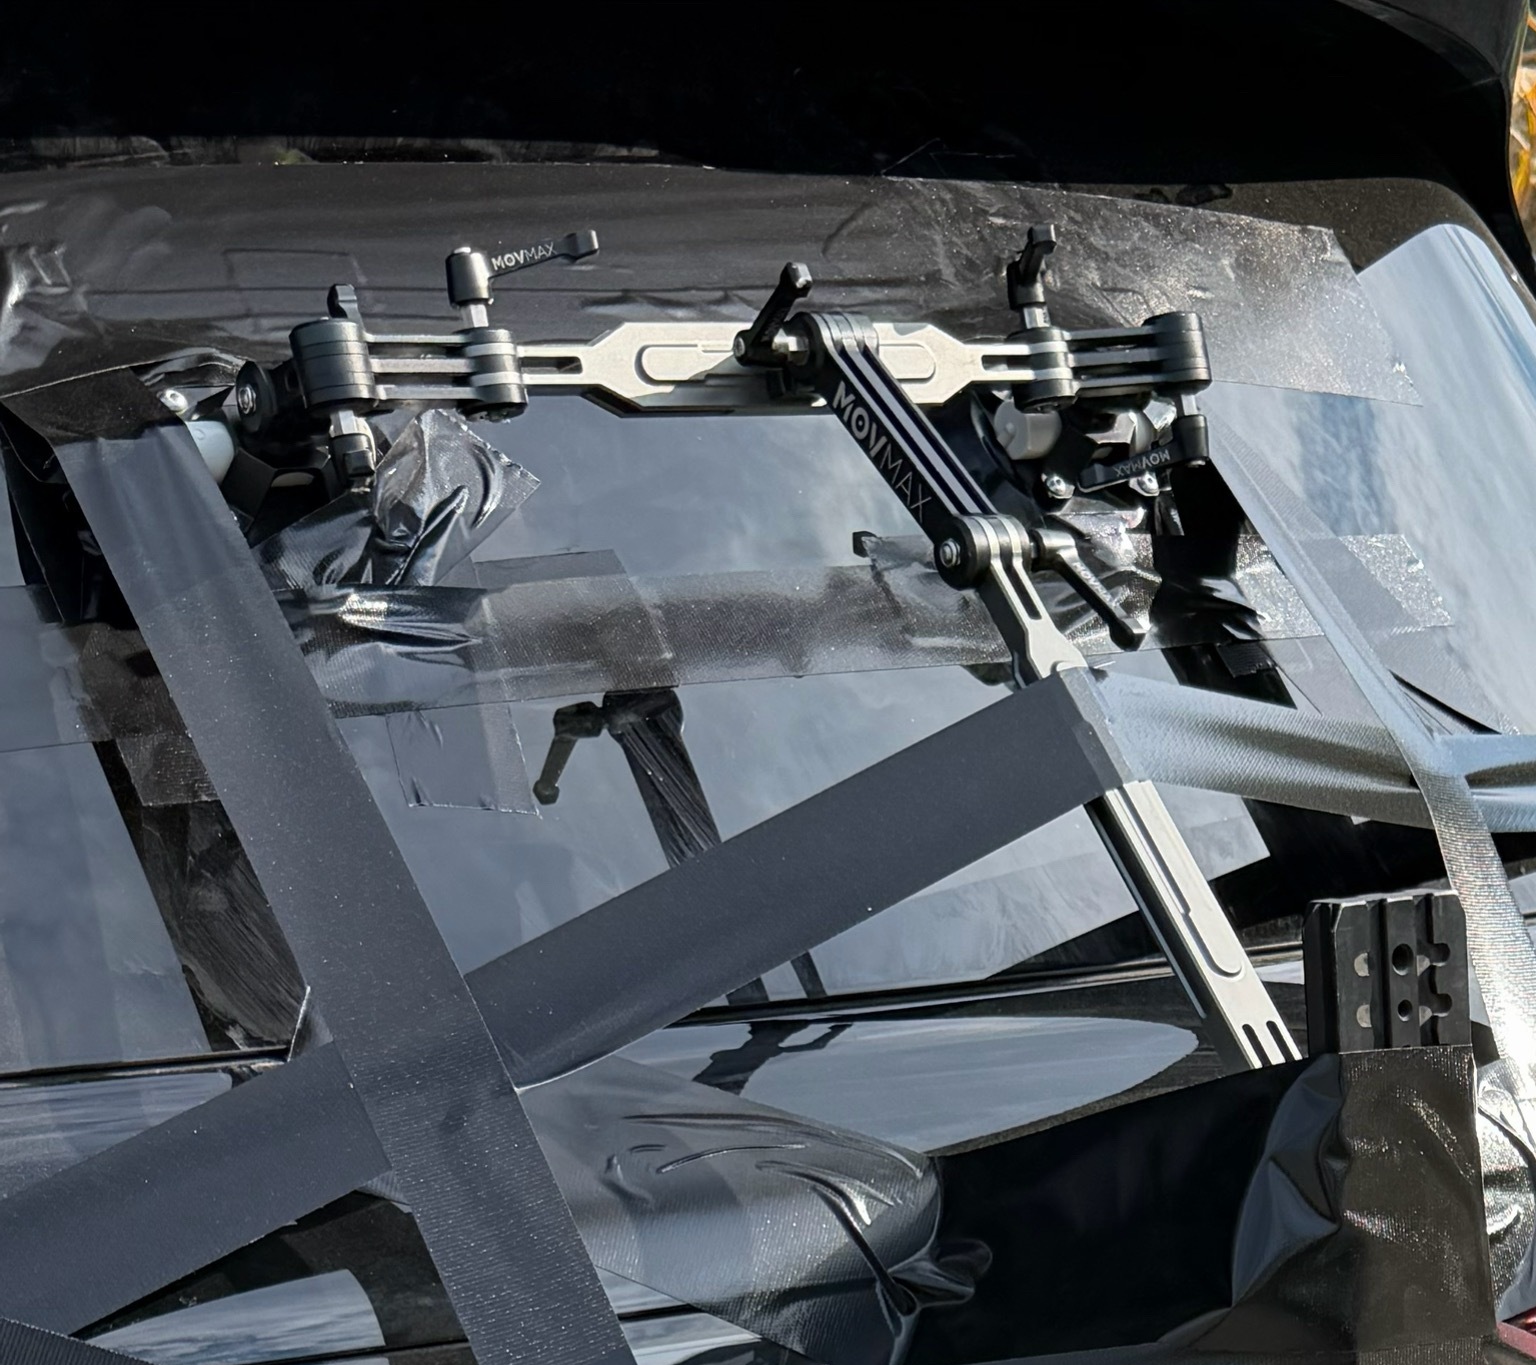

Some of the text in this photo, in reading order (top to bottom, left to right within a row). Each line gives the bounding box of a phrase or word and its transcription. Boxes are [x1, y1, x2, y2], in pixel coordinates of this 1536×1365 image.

[490, 241, 558, 271] MOVMAX
[832, 380, 932, 523] MOVMAX
[1113, 448, 1171, 478] MOVMAX
